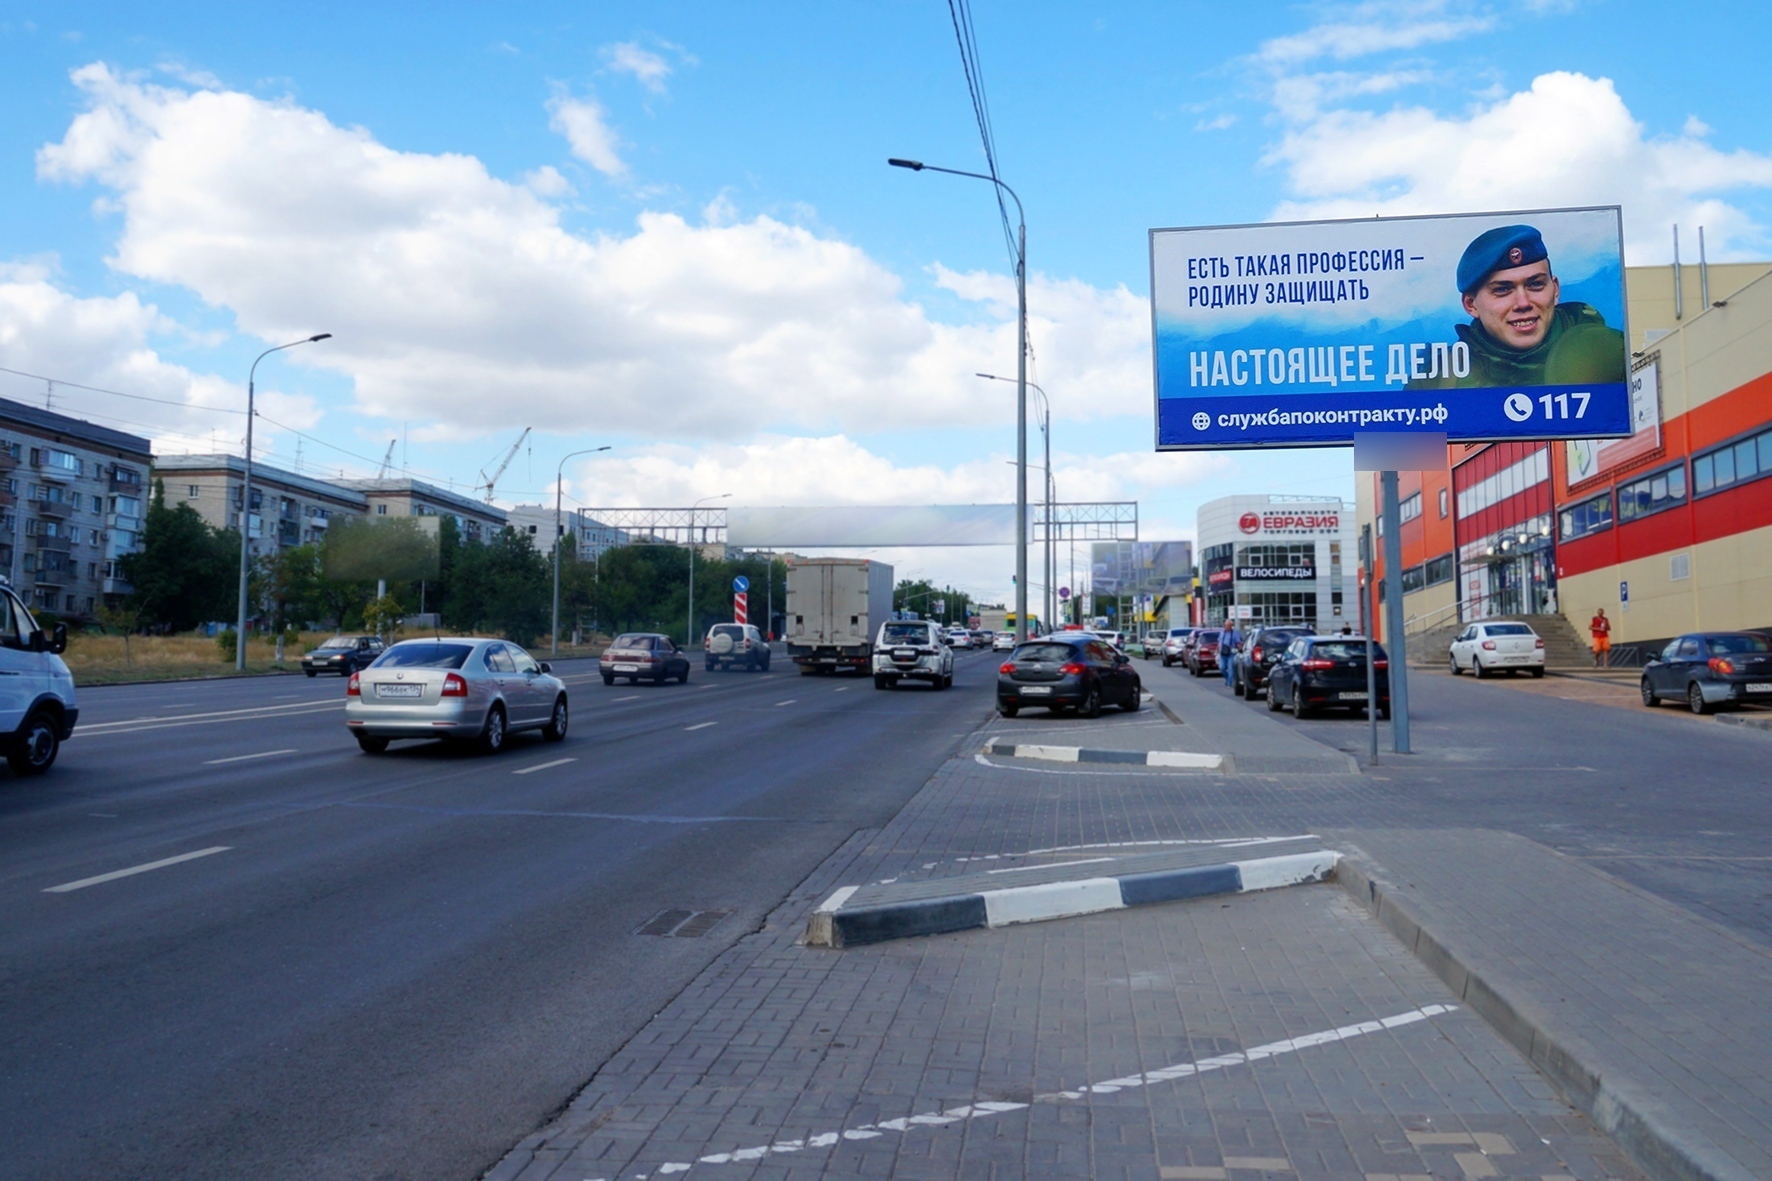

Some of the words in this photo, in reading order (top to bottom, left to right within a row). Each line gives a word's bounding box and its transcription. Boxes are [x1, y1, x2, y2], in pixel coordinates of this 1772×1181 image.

[1188, 257, 1230, 279] ЕСТЬ
[1235, 253, 1291, 277] ТАКАЯ
[1296, 248, 1405, 275] ПРОФЕССИЯ
[1188, 283, 1260, 309] РОДИНУ
[1265, 278, 1370, 305] ЗАЩИЩАТЬ
[1189, 344, 1375, 387] НАСТОЯЩЕЕ
[1385, 340, 1471, 385] ДЕЛО
[1217, 403, 1448, 431] службапоконтракту.рф
[1538, 392, 1591, 420] 117
[1263, 516, 1339, 529] ЕВРАЗИЯ
[1240, 568, 1312, 579] ВЕЛОСИПЕДЫ
